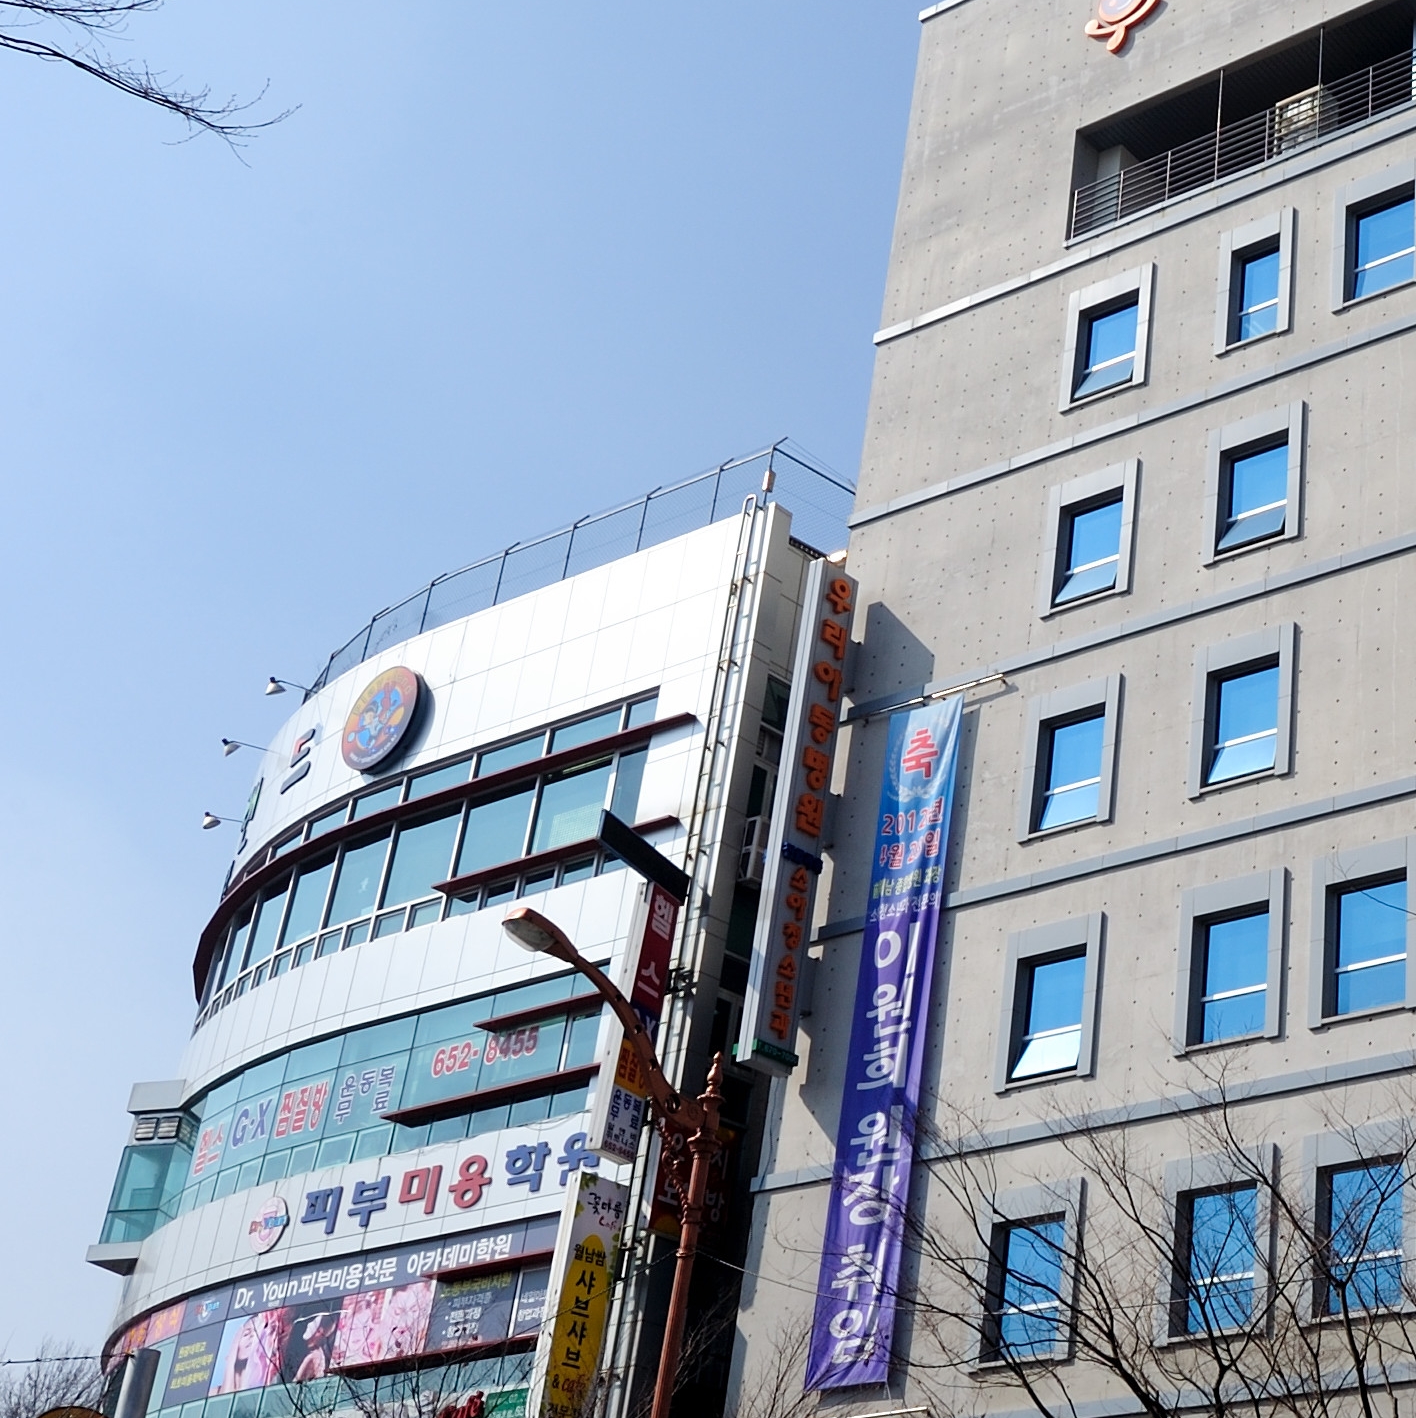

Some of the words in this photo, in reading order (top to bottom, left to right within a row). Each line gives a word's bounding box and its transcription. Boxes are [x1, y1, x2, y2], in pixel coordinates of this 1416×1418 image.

[796, 578, 852, 838] 우리아동병원
[902, 727, 939, 779] 축
[881, 795, 944, 836] 2012년
[637, 893, 675, 999] 헬스
[192, 1122, 225, 1177] 헬스
[274, 1079, 330, 1140] 찜질방
[300, 1130, 600, 1235] 피부미용학원
[406, 1233, 513, 1277] 아카데미학원
[561, 1268, 597, 1371] 샤브샤브
